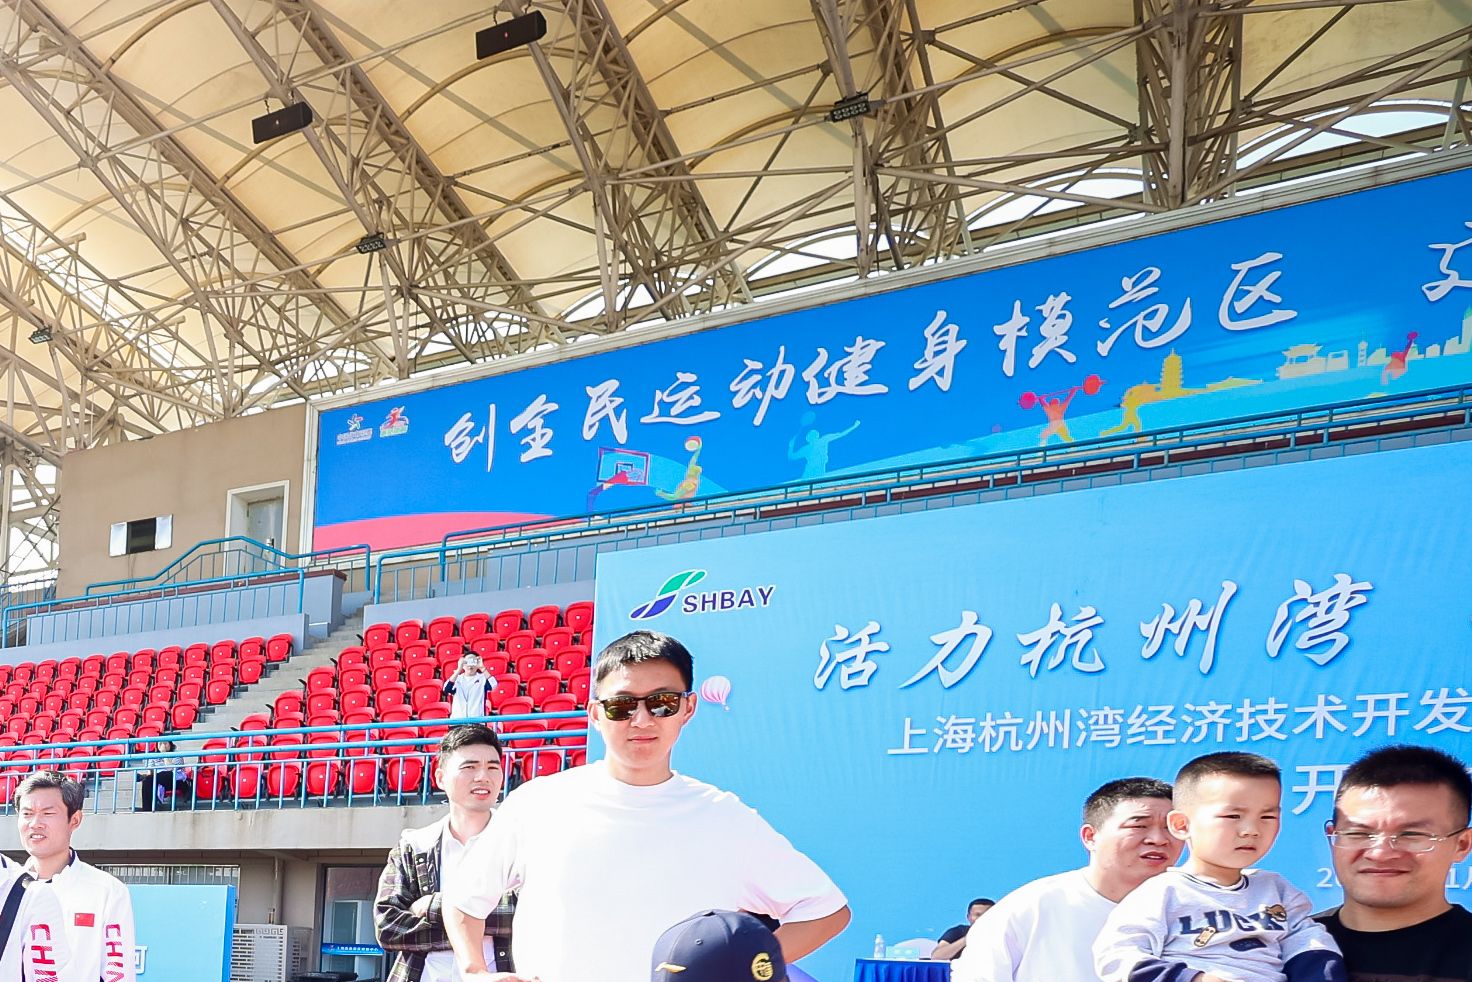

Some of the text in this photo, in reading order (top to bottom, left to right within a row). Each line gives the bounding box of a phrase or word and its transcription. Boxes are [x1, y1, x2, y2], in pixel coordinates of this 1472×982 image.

[444, 252, 1298, 472] 创全民运动健身模范区
[682, 586, 774, 613] SHBAY
[813, 573, 1374, 690] 活力杭州湾
[886, 686, 1472, 755] 上海杭州湾经济技术开发
[1178, 909, 1285, 936] LUCK
